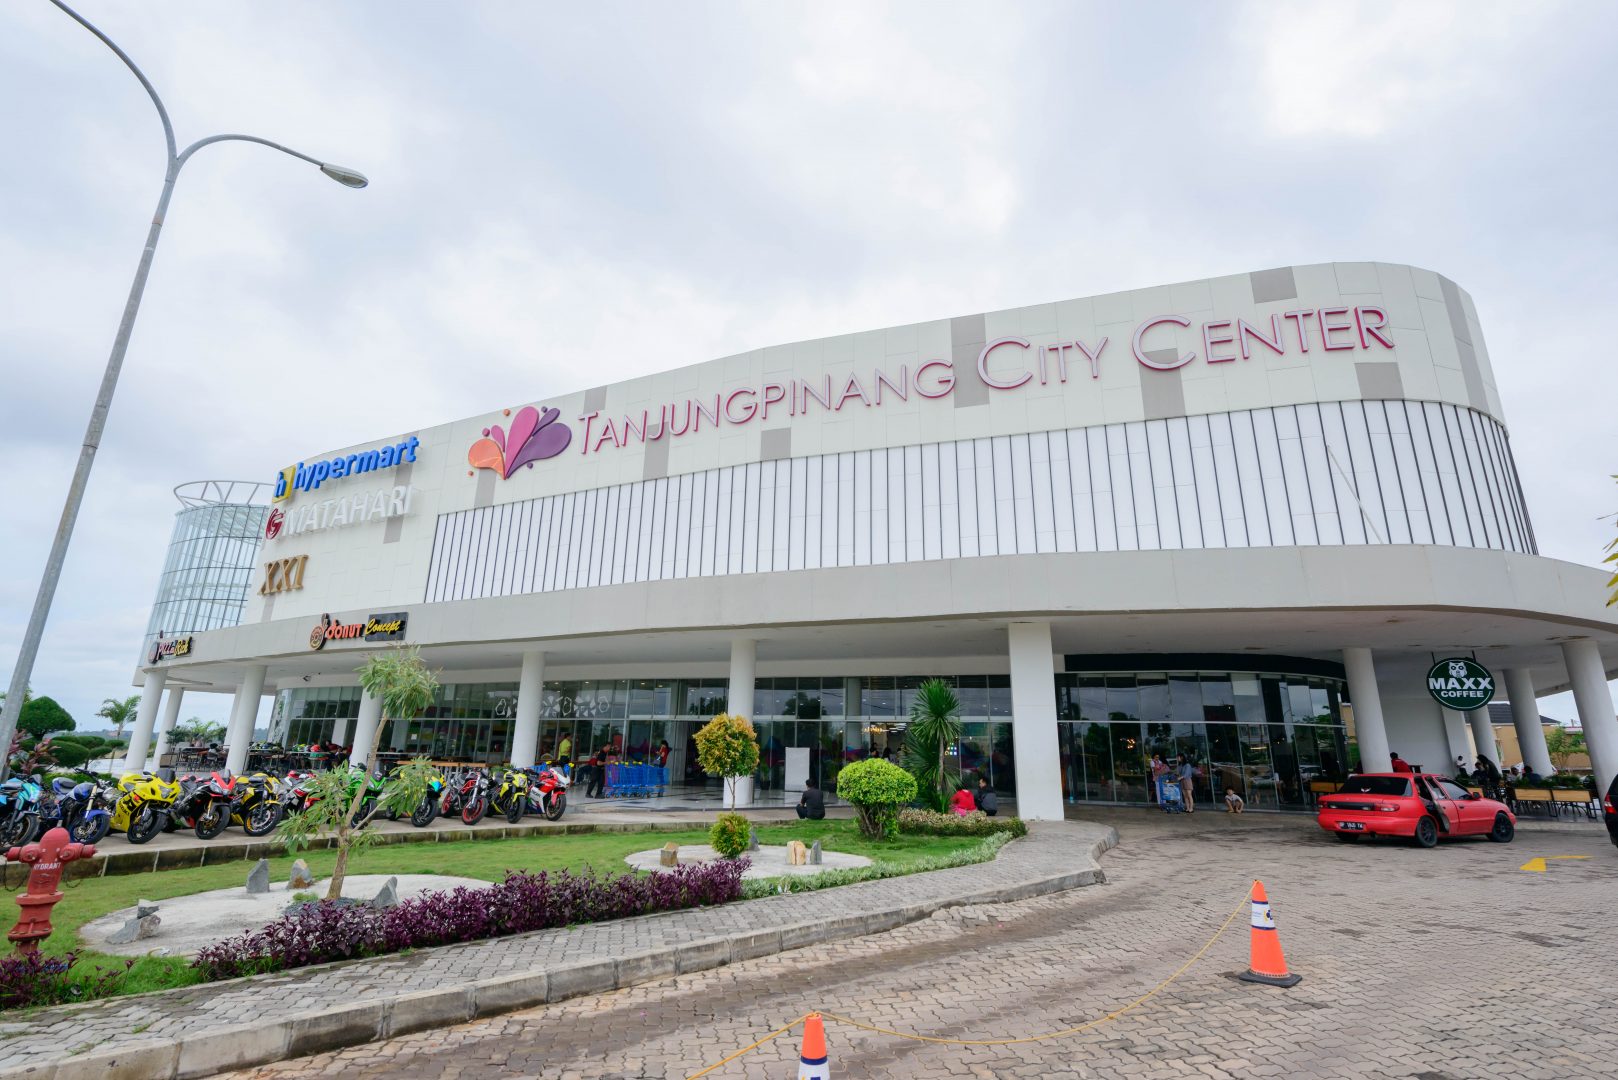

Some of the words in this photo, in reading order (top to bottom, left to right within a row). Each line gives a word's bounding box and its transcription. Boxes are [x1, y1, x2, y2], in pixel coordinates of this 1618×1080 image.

[578, 358, 956, 455] TANJUNGPINANG
[976, 335, 1109, 390] CITY
[1132, 305, 1396, 371] CENTER
[294, 436, 419, 491] hypermart
[283, 485, 412, 536] MATAHARI
[258, 554, 308, 595] XXI
[1428, 677, 1494, 690] MAXX
[1440, 690, 1485, 698] COFFEE
[32, 861, 62, 871] HYDRANT
